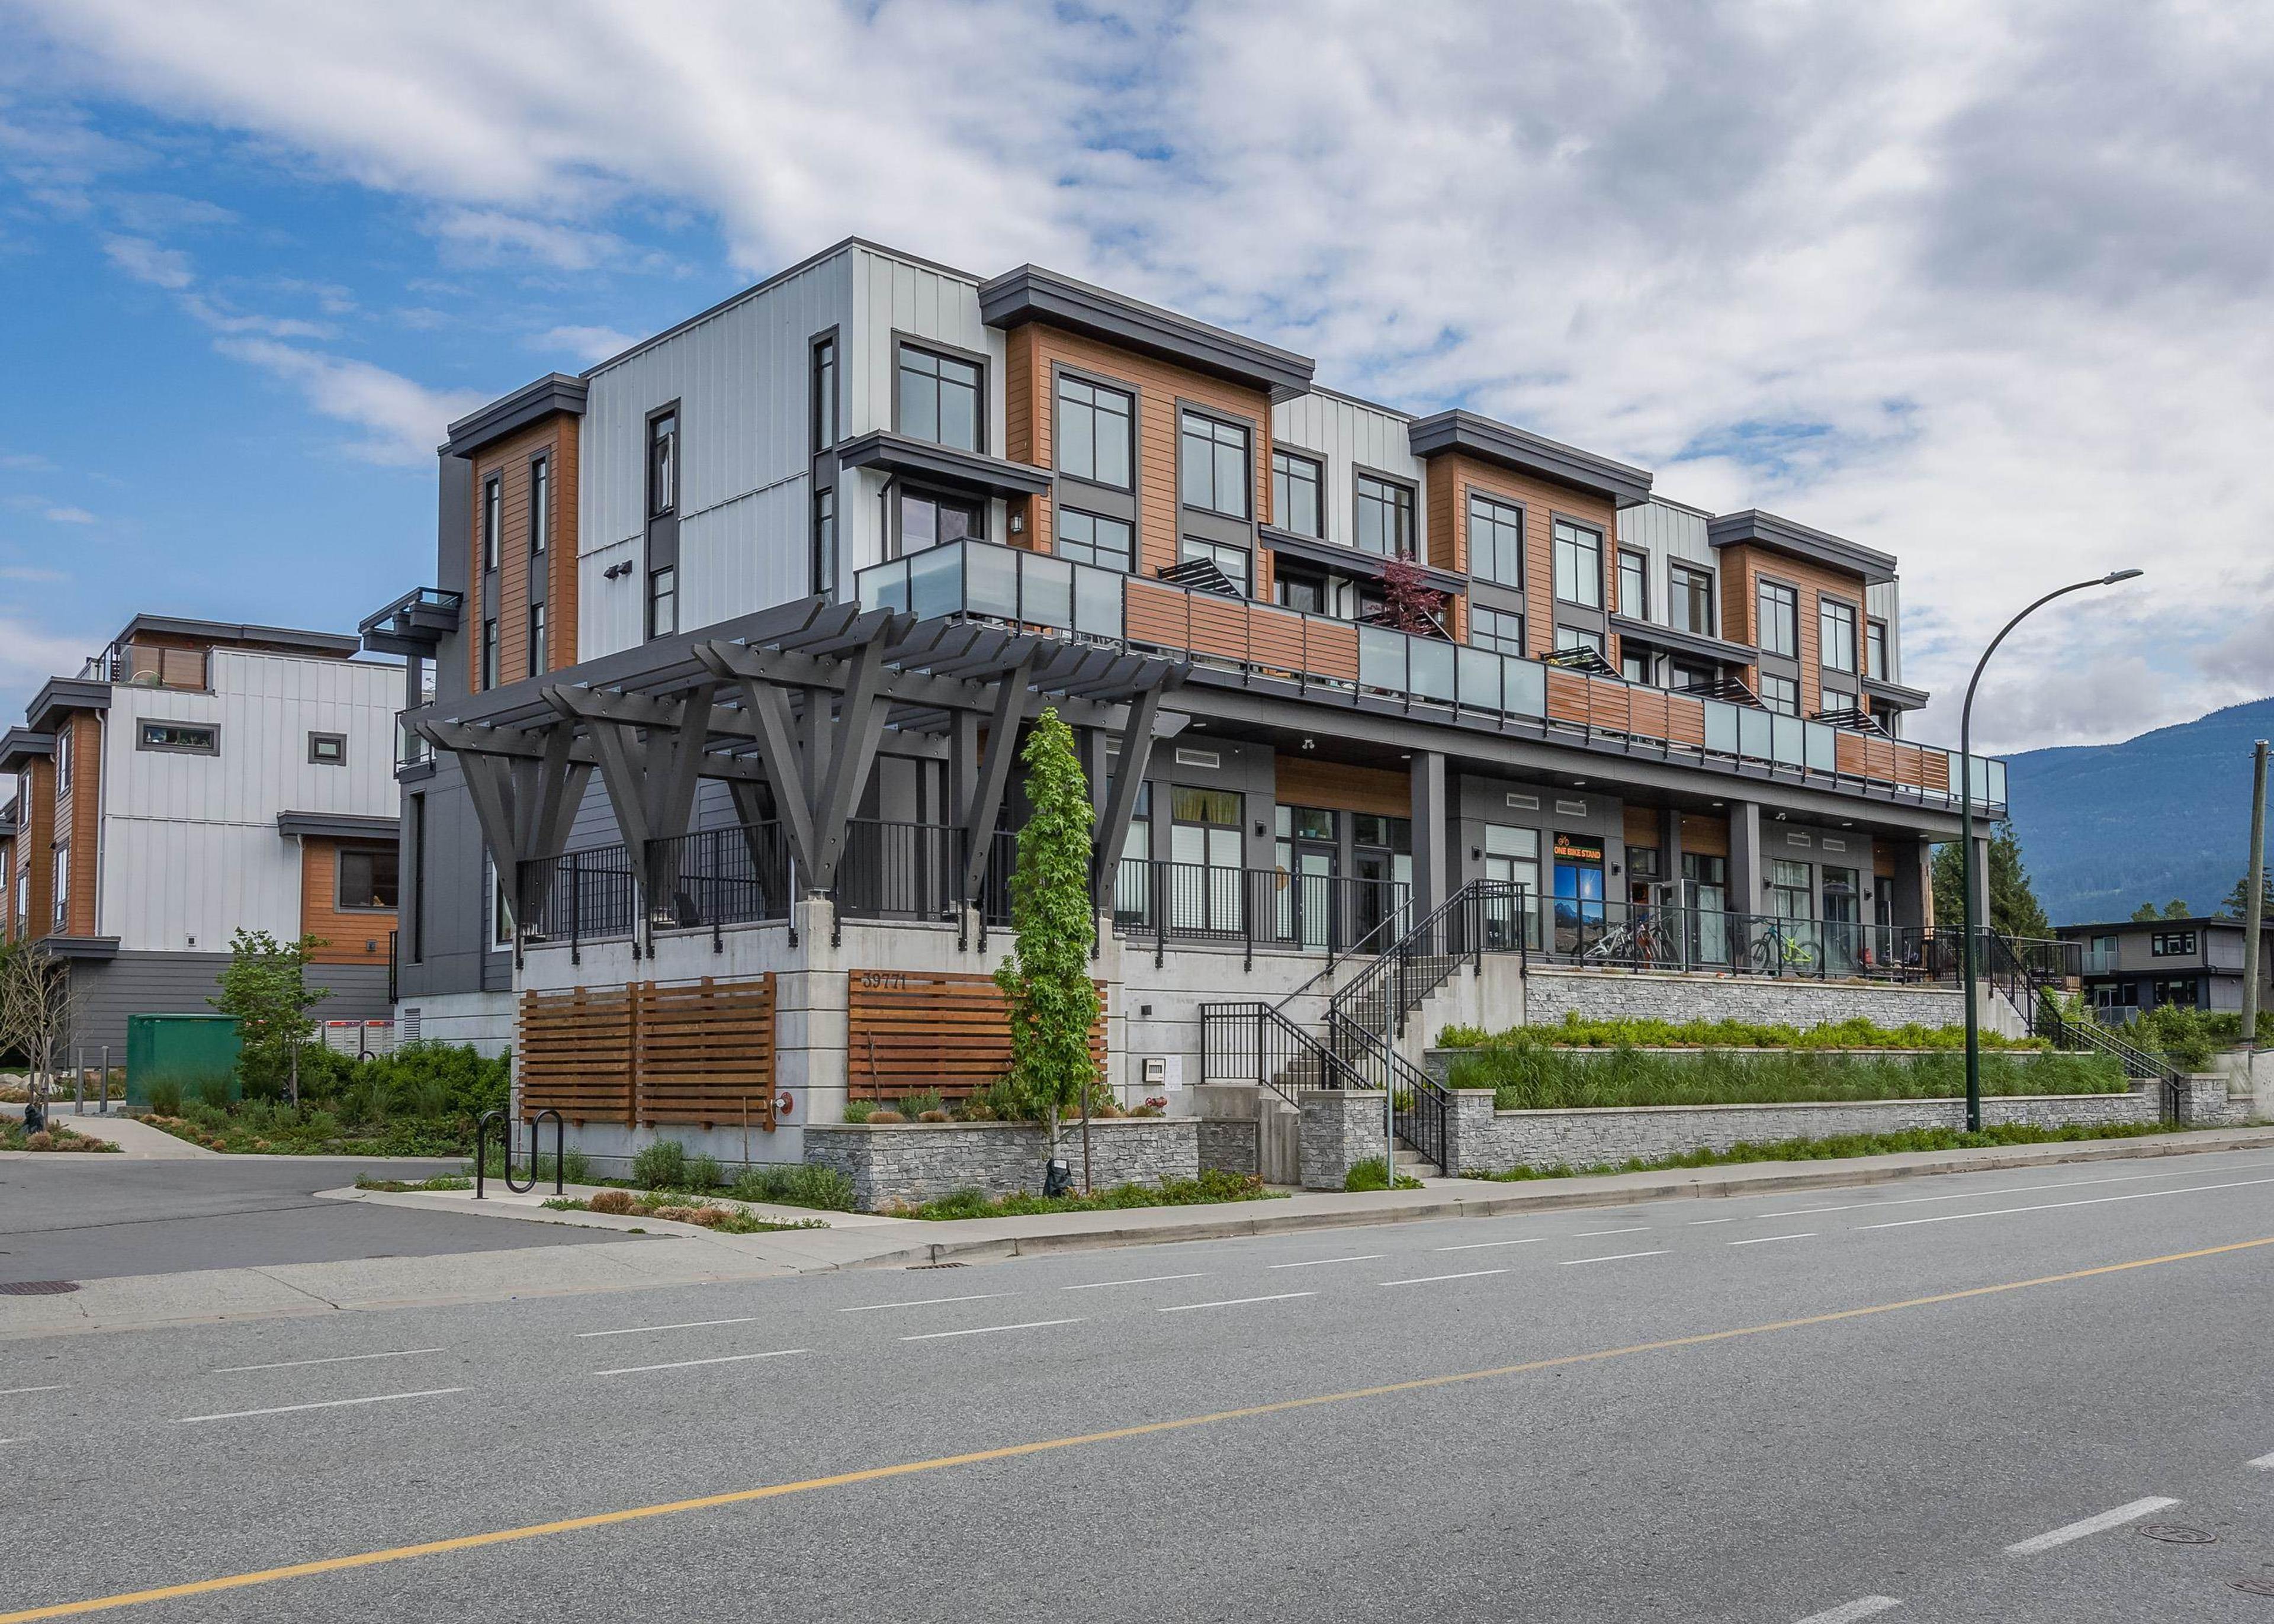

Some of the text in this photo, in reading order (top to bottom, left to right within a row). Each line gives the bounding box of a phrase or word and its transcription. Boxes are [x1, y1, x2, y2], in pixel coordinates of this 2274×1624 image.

[1554, 846, 1601, 858] ONE BIKE STAND
[863, 972, 906, 990] 39771
